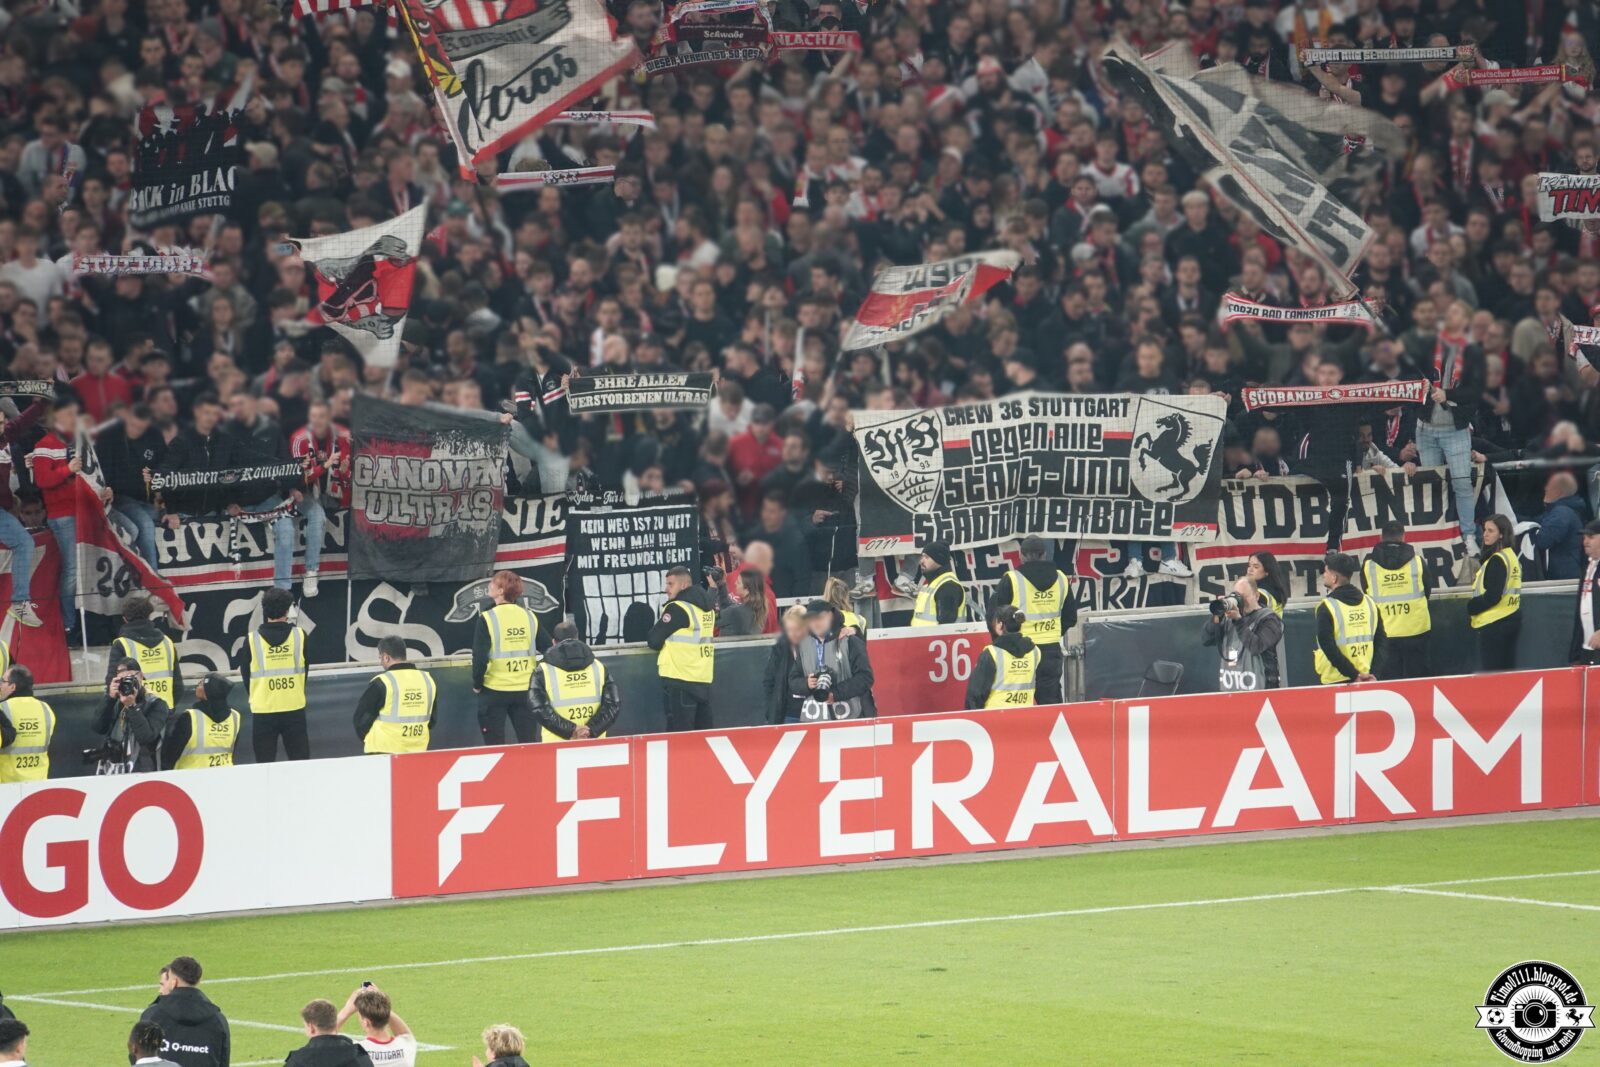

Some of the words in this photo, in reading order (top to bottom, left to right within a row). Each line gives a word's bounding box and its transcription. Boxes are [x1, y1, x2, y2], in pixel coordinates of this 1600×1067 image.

[168, 182, 186, 205] in
[78, 256, 203, 274] STUTTGART
[594, 376, 637, 390] EHRE
[637, 375, 689, 387] ALLEN
[571, 394, 662, 410] VERSTORBENEN
[664, 392, 709, 404] ULTRAS
[1248, 391, 1323, 406] SÜDBANDE
[1348, 383, 1422, 400] STUTTGART
[943, 403, 993, 426] CREW
[1001, 399, 1024, 421] 36
[1028, 396, 1131, 417] STUTTGART
[151, 470, 219, 491] Schwaben
[365, 490, 493, 526] ULTRAS
[581, 519, 604, 534] KEIN
[607, 518, 630, 533] WEG
[633, 517, 651, 531] IST
[654, 516, 663, 530] ZU
[667, 514, 691, 529] WEIT
[1180, 524, 1207, 537] 1312
[591, 536, 625, 551] WENN
[631, 533, 654, 549] MAN
[578, 555, 600, 569] MIT
[603, 551, 663, 568] FREUNDEN
[666, 548, 692, 563] GEHT
[1384, 574, 1405, 582] SDS
[1034, 590, 1053, 600] SDS
[1385, 603, 1410, 615] 1179
[1349, 612, 1365, 622] SDS
[1033, 619, 1056, 632] 1762
[507, 628, 526, 637] SDS
[142, 648, 161, 658] SDS
[268, 644, 290, 654] SDS
[506, 660, 529, 672] 1217
[929, 638, 971, 683] 36
[1011, 660, 1029, 670] SDS
[566, 672, 588, 682] SDS
[268, 677, 295, 691] 0685
[404, 692, 422, 701] SDS
[1005, 692, 1028, 704] 2409
[568, 706, 594, 720] 2329
[19, 722, 39, 731] SDS
[210, 723, 229, 732] SDS
[402, 724, 423, 737] 2169
[16, 756, 40, 768] 2323
[555, 677, 1543, 874] FLYERALARM
[0, 780, 204, 918] GO
